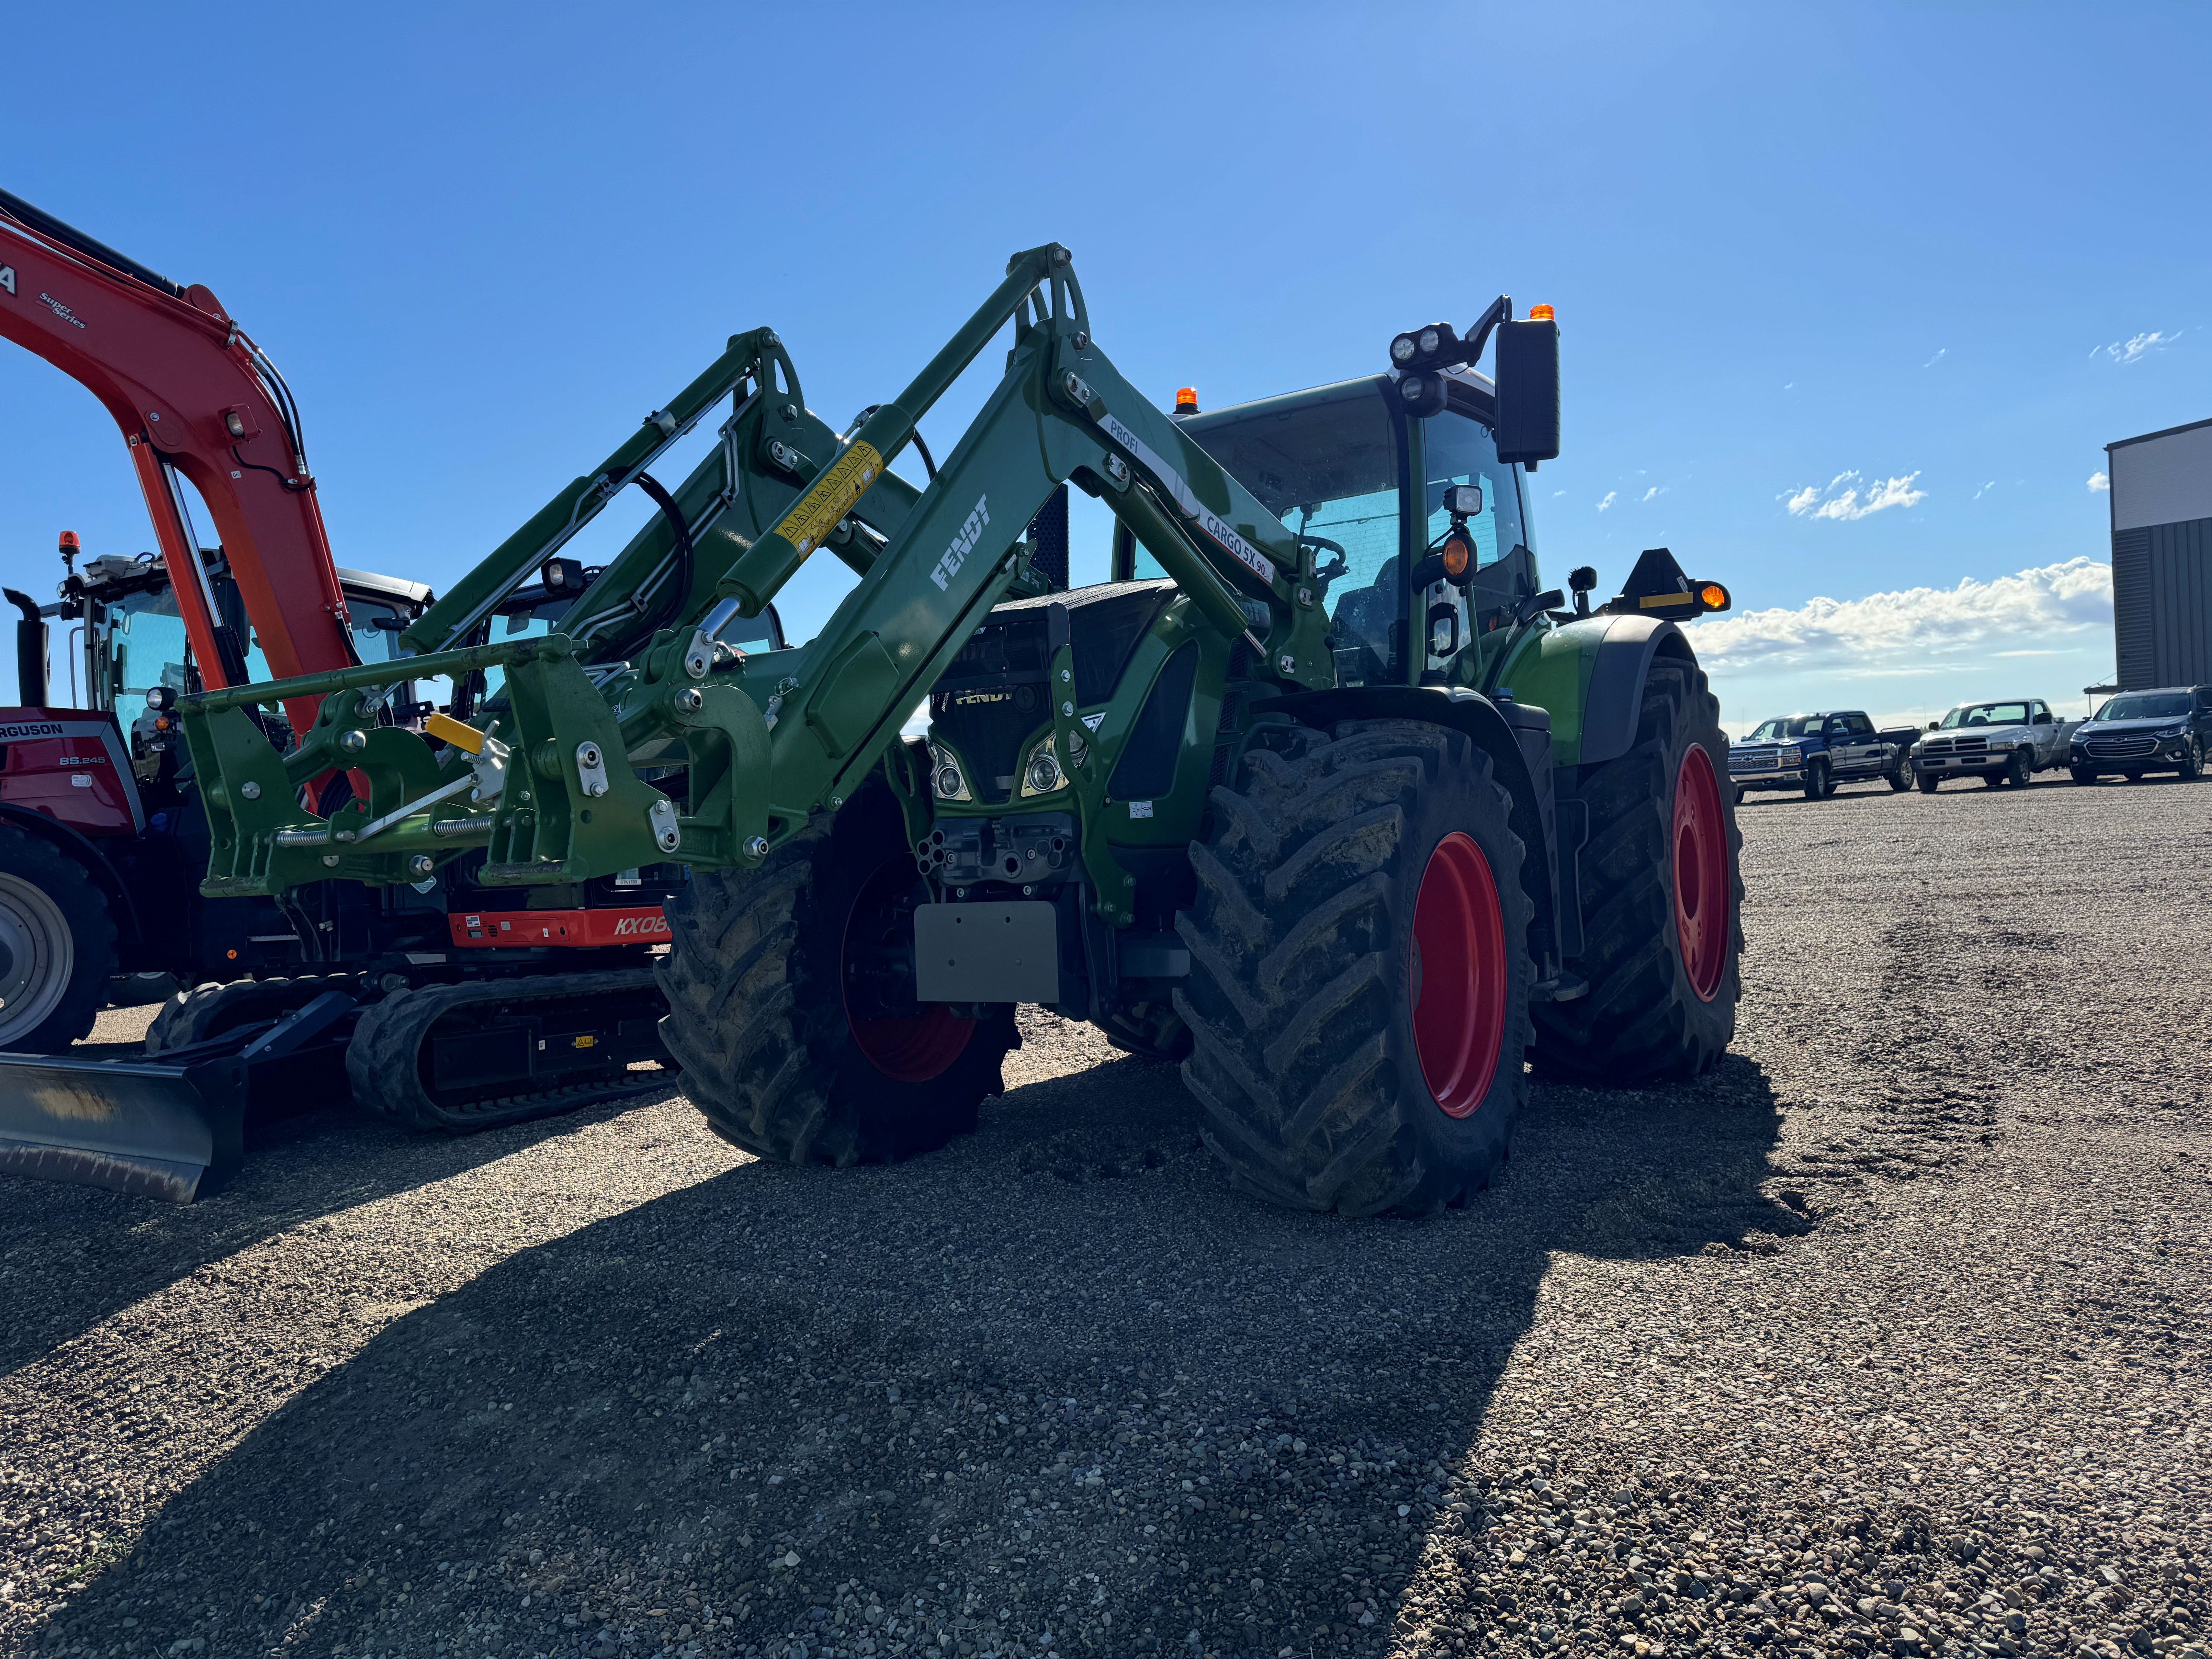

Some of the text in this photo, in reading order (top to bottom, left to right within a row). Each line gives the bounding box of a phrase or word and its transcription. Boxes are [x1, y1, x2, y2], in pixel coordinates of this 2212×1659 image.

[0, 262, 16, 295] A
[40, 293, 72, 313] Super
[52, 308, 86, 329] Series
[1111, 420, 1138, 454] PROFI
[930, 493, 990, 591] FENDT
[1207, 516, 1265, 575] CARGO 5X 90
[954, 684, 1017, 705] FENDT
[59, 756, 106, 766] 8S.245
[614, 915, 671, 935] KX08
